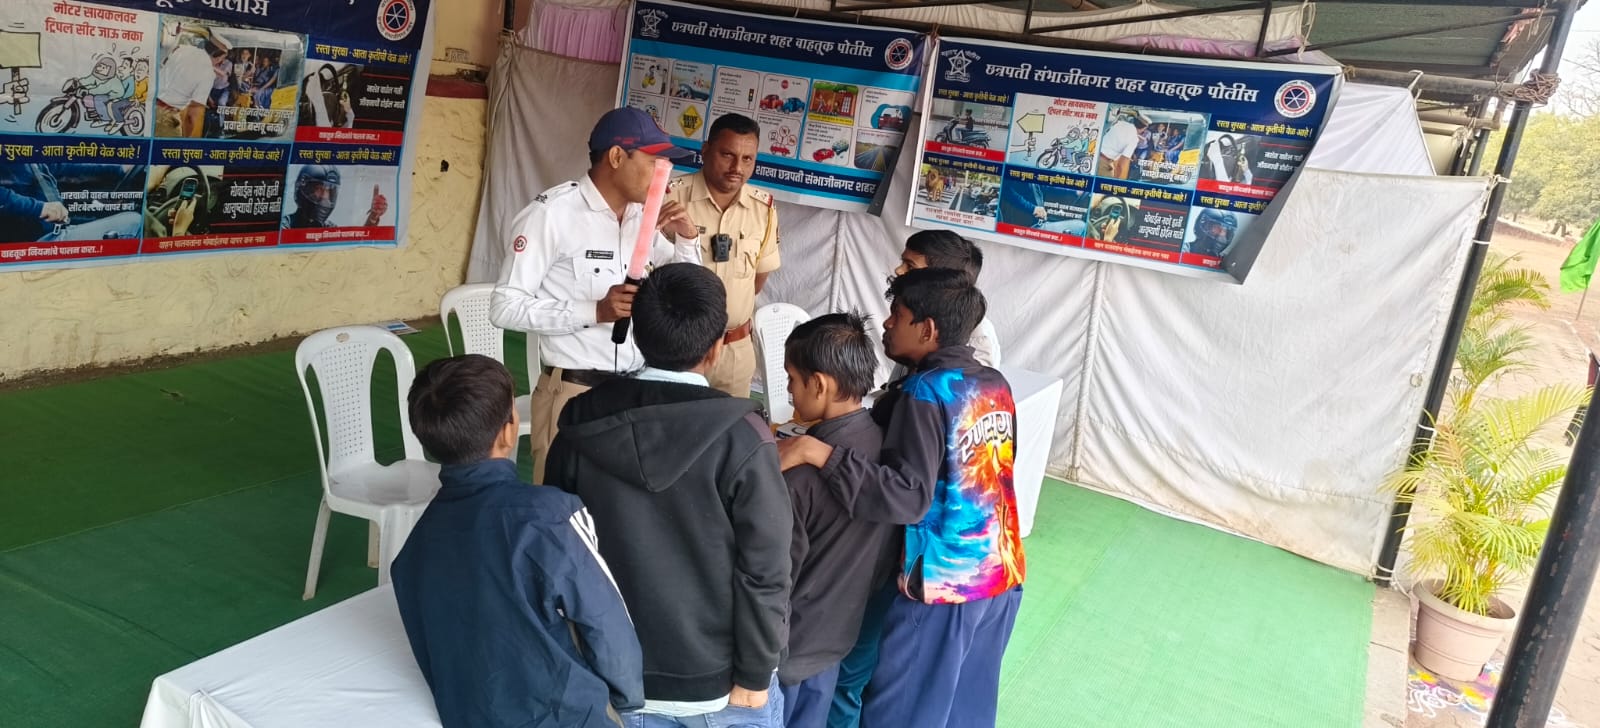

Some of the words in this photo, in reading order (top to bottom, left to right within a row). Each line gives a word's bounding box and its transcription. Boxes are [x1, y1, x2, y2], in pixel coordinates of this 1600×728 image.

[54, 2, 81, 16] मोटर
[83, 6, 137, 24] सायकलवर
[45, 17, 74, 34] ट्रिपल
[75, 22, 96, 37] सीट
[98, 26, 119, 39] जाऊ
[121, 30, 143, 42] नका
[672, 21, 708, 36] छत्रपती
[709, 23, 767, 44] संभाजीनगर
[770, 34, 793, 48] शहर
[795, 37, 835, 56] वाहतूक
[985, 63, 1032, 80] छत्रपती
[1034, 66, 1111, 89] संभाजीनगर
[1115, 77, 1147, 93] शहर
[1150, 80, 1205, 102] वाहतूक
[223, 119, 246, 132] प्रवासी
[247, 121, 266, 134] बसवू
[5, 144, 33, 161] सुरक्षा
[41, 145, 64, 157] आता
[65, 143, 98, 161] कृतीची
[100, 144, 114, 158] वेळ
[116, 144, 135, 159] आहे
[162, 148, 180, 159] रस्ता
[182, 149, 203, 163] सुरक्षा
[209, 149, 227, 159] आता
[228, 147, 251, 163] कृतीची
[252, 148, 265, 159] वेळ
[265, 148, 280, 161] आहे
[755, 165, 777, 178] शाखा
[778, 169, 804, 183] छत्रपती
[805, 173, 855, 191] संभाजीनगर
[855, 182, 877, 194] शहर
[90, 192, 109, 201] वाहन
[230, 180, 253, 199] मोबाईल
[253, 180, 266, 197] नको
[266, 180, 280, 198] हाती
[105, 203, 120, 211] वापर
[121, 202, 134, 211] करा
[223, 198, 253, 219] आयुष्याची
[253, 198, 269, 215] होईल
[1, 250, 26, 260] वाहतूक
[28, 245, 58, 256] नियमांचे
[59, 247, 79, 255] पालन
